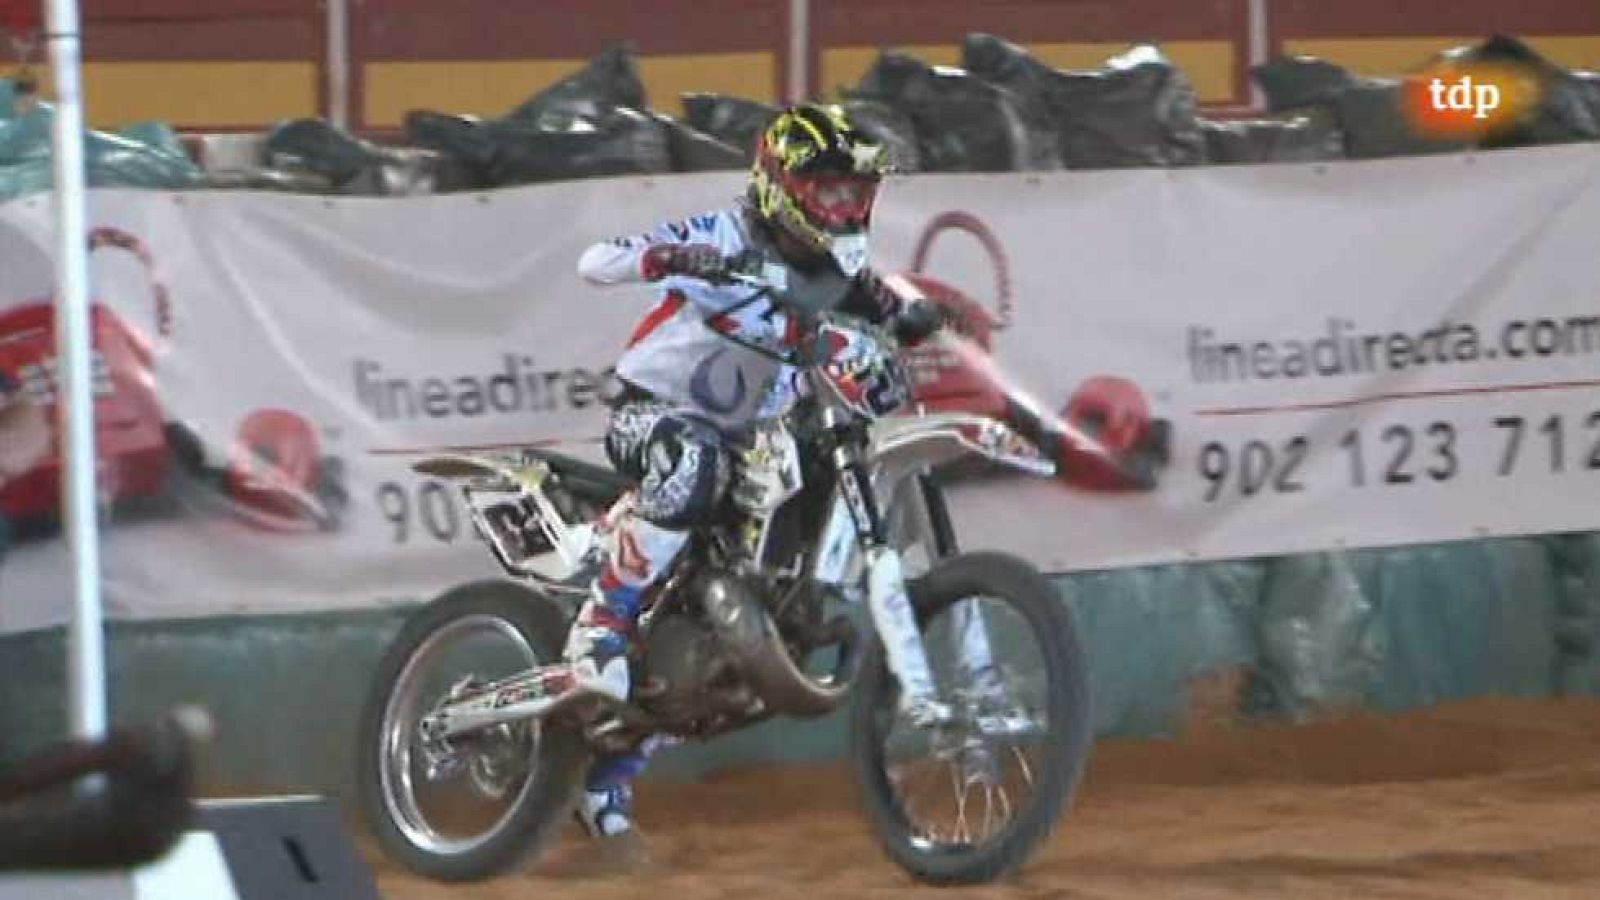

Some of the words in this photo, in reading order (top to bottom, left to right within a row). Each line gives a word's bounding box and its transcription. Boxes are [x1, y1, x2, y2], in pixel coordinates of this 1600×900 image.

[1200, 436, 1309, 501] 902
[1339, 420, 1458, 488] 123
[1494, 412, 1600, 477] 712
